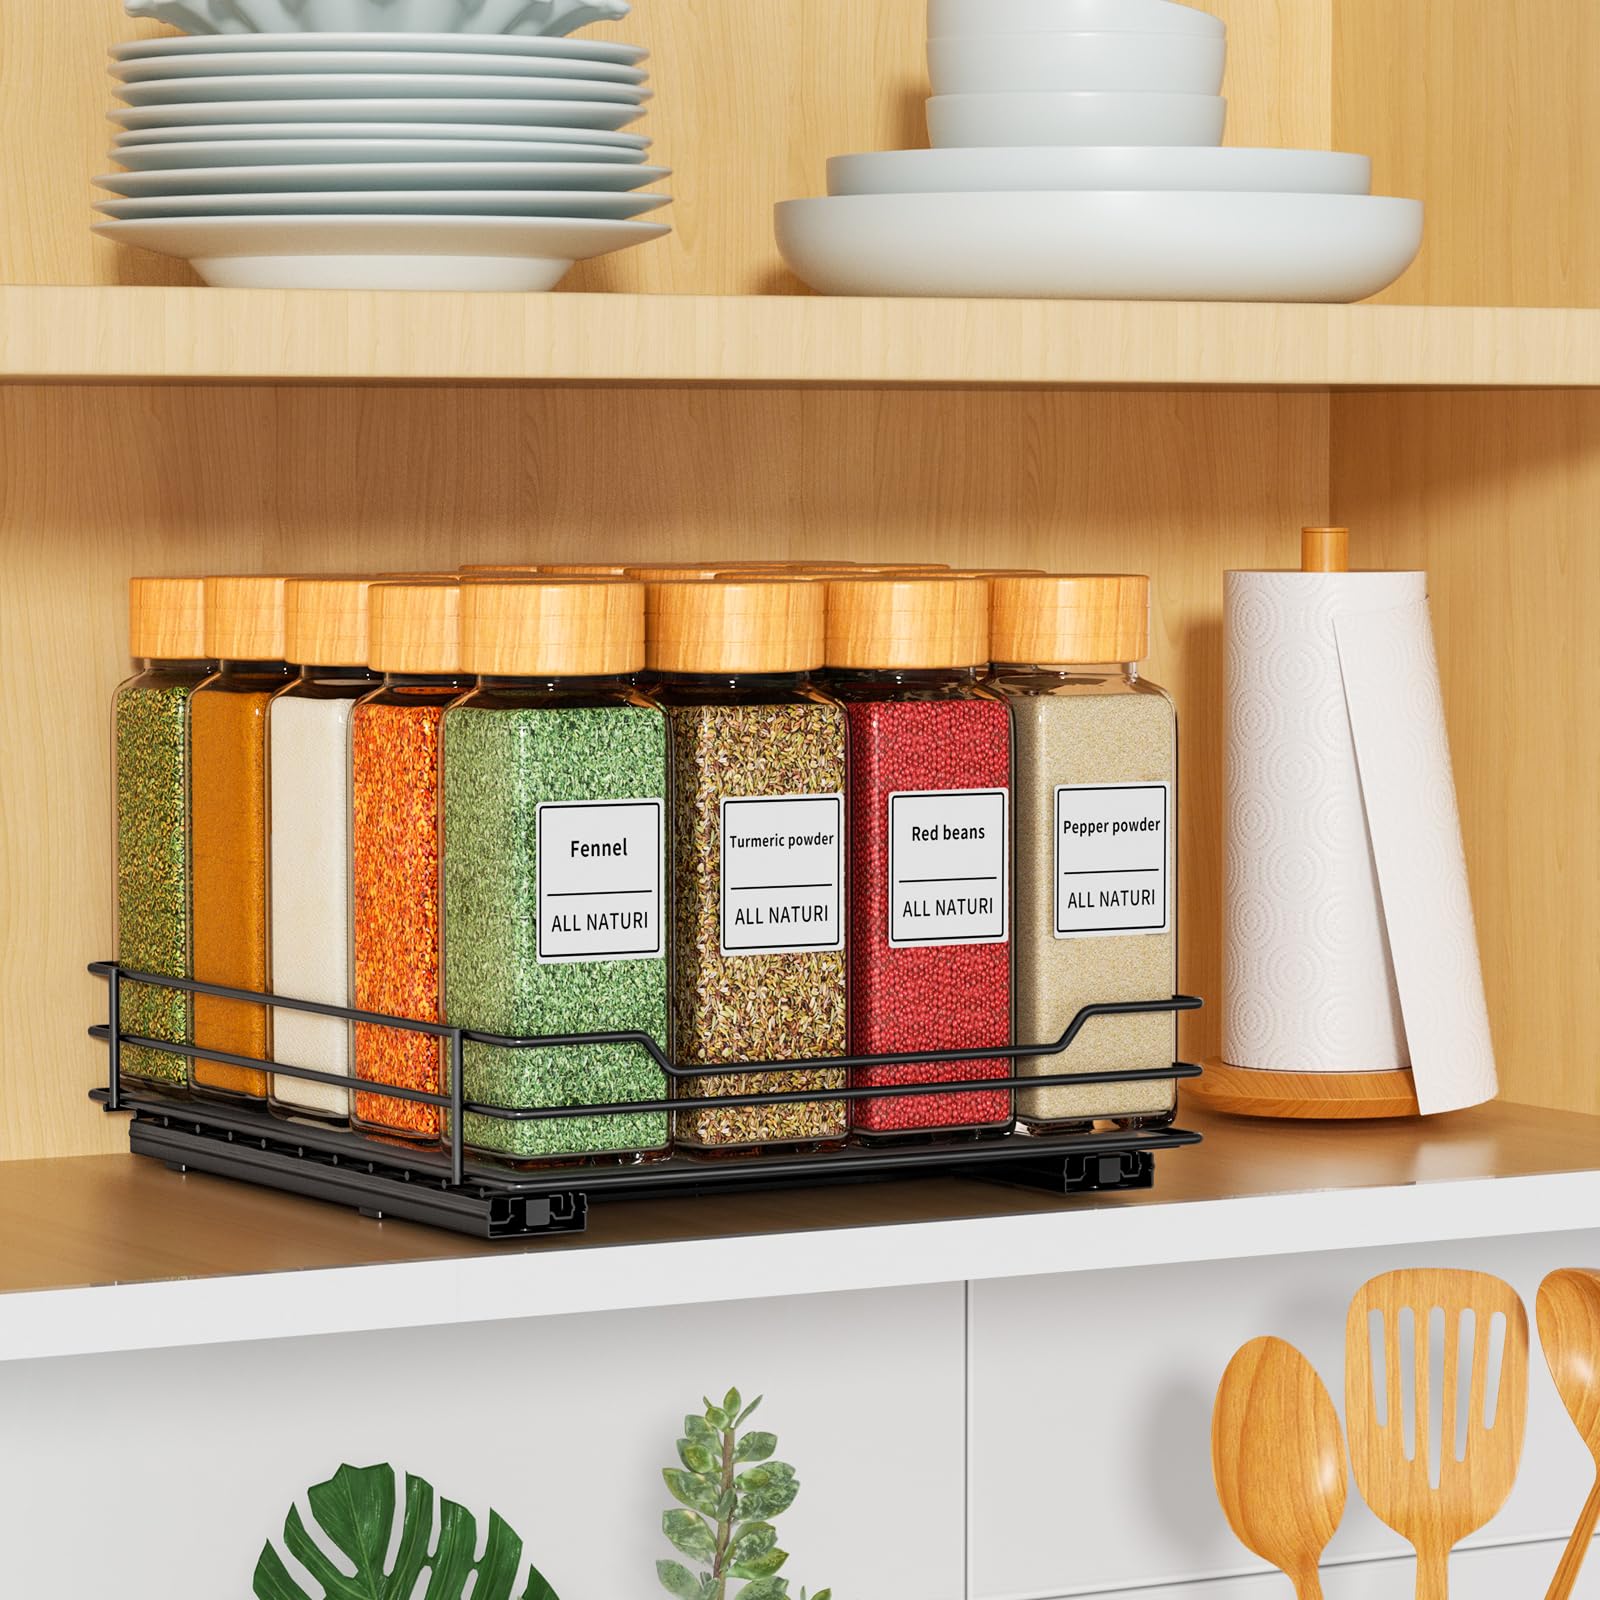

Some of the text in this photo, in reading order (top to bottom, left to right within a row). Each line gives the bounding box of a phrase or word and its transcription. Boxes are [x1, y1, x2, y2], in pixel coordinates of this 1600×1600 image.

[912, 824, 985, 842] Red beans
[1063, 816, 1161, 838] Pepper powder
[571, 837, 628, 858] Fennel
[729, 831, 834, 850] Turmeric powder
[902, 897, 993, 918] ALL NATURI
[1067, 888, 1155, 909] ALL NATURI
[551, 911, 648, 933] ALL NATURI
[734, 904, 828, 925] ALL NATURI
